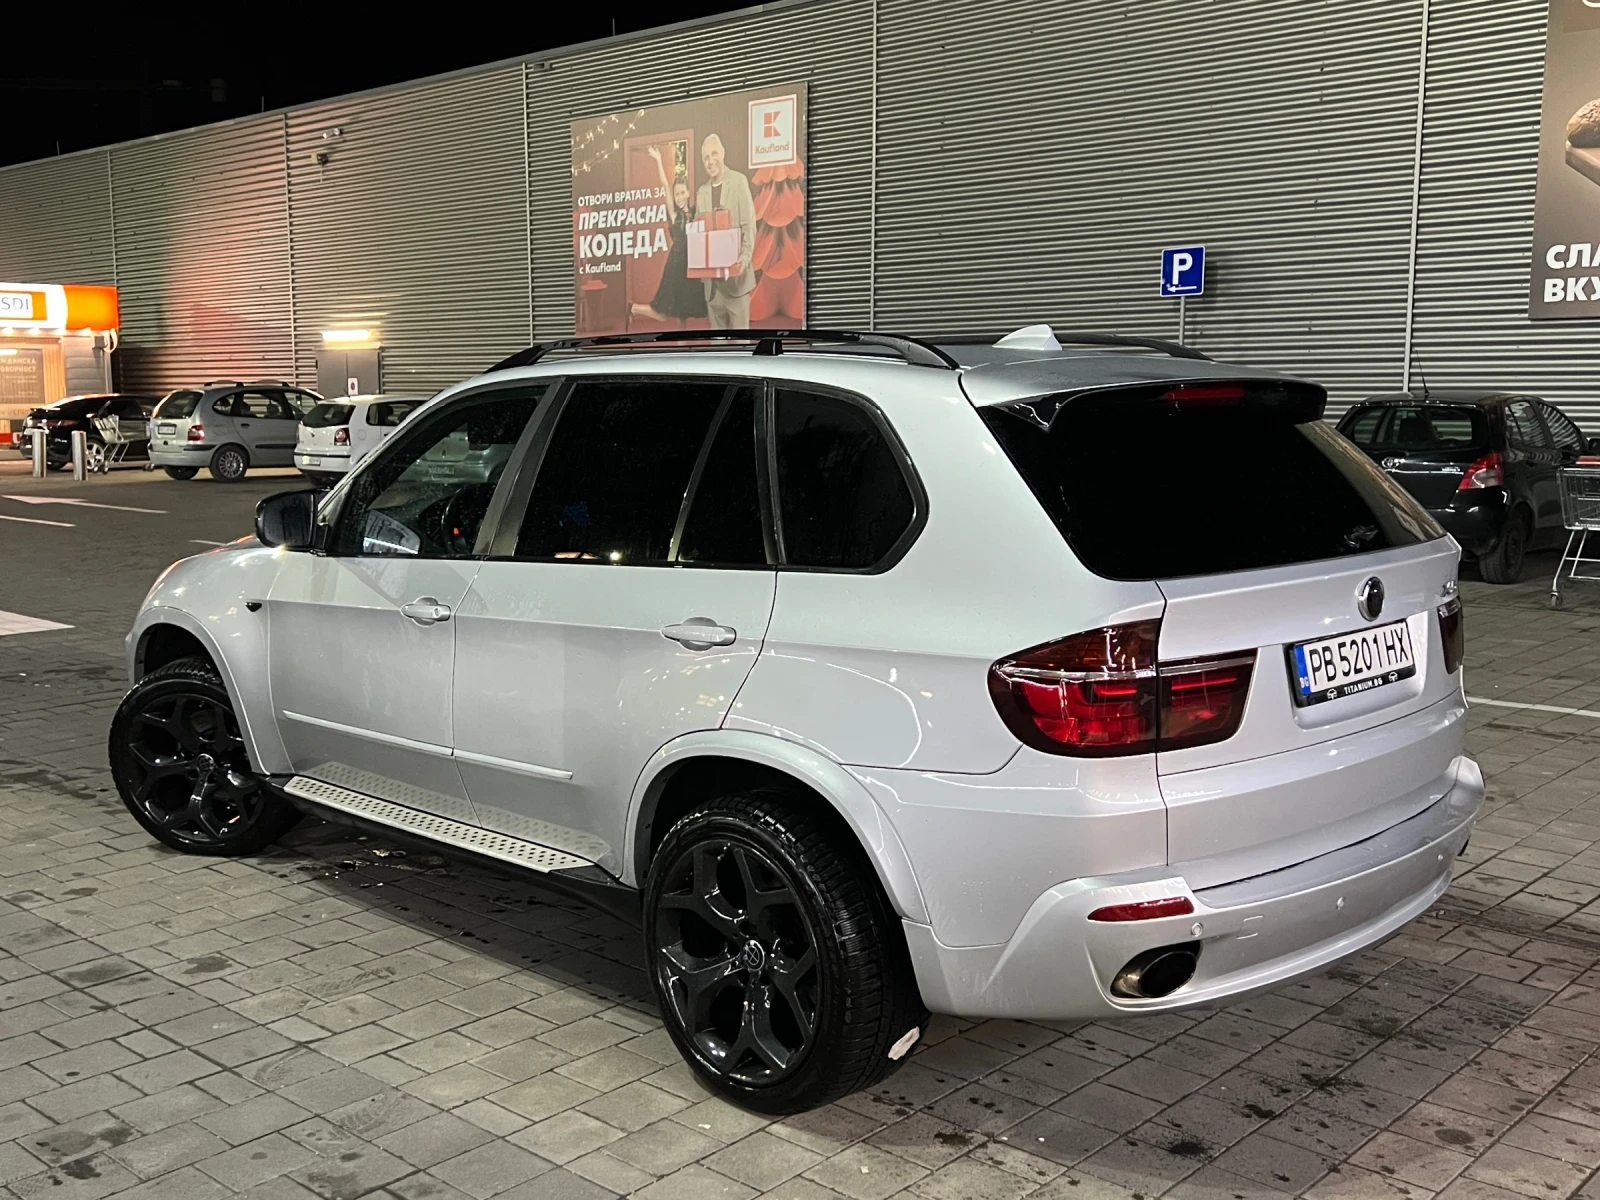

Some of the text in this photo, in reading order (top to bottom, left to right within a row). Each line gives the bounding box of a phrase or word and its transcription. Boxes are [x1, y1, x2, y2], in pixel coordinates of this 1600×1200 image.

[755, 142, 789, 154] Kaufland
[578, 187, 666, 207] ОТВОРИ ВРАТАТА ЗА
[578, 204, 668, 230] ПРЕКРАСНА
[579, 228, 668, 259] КОЛЕДА
[579, 261, 621, 274] с Kaufland
[1172, 252, 1193, 285] P
[1, 296, 29, 311] SDI
[1299, 677, 1310, 689] BG
[1343, 677, 1383, 695] TITANIUM.BG
